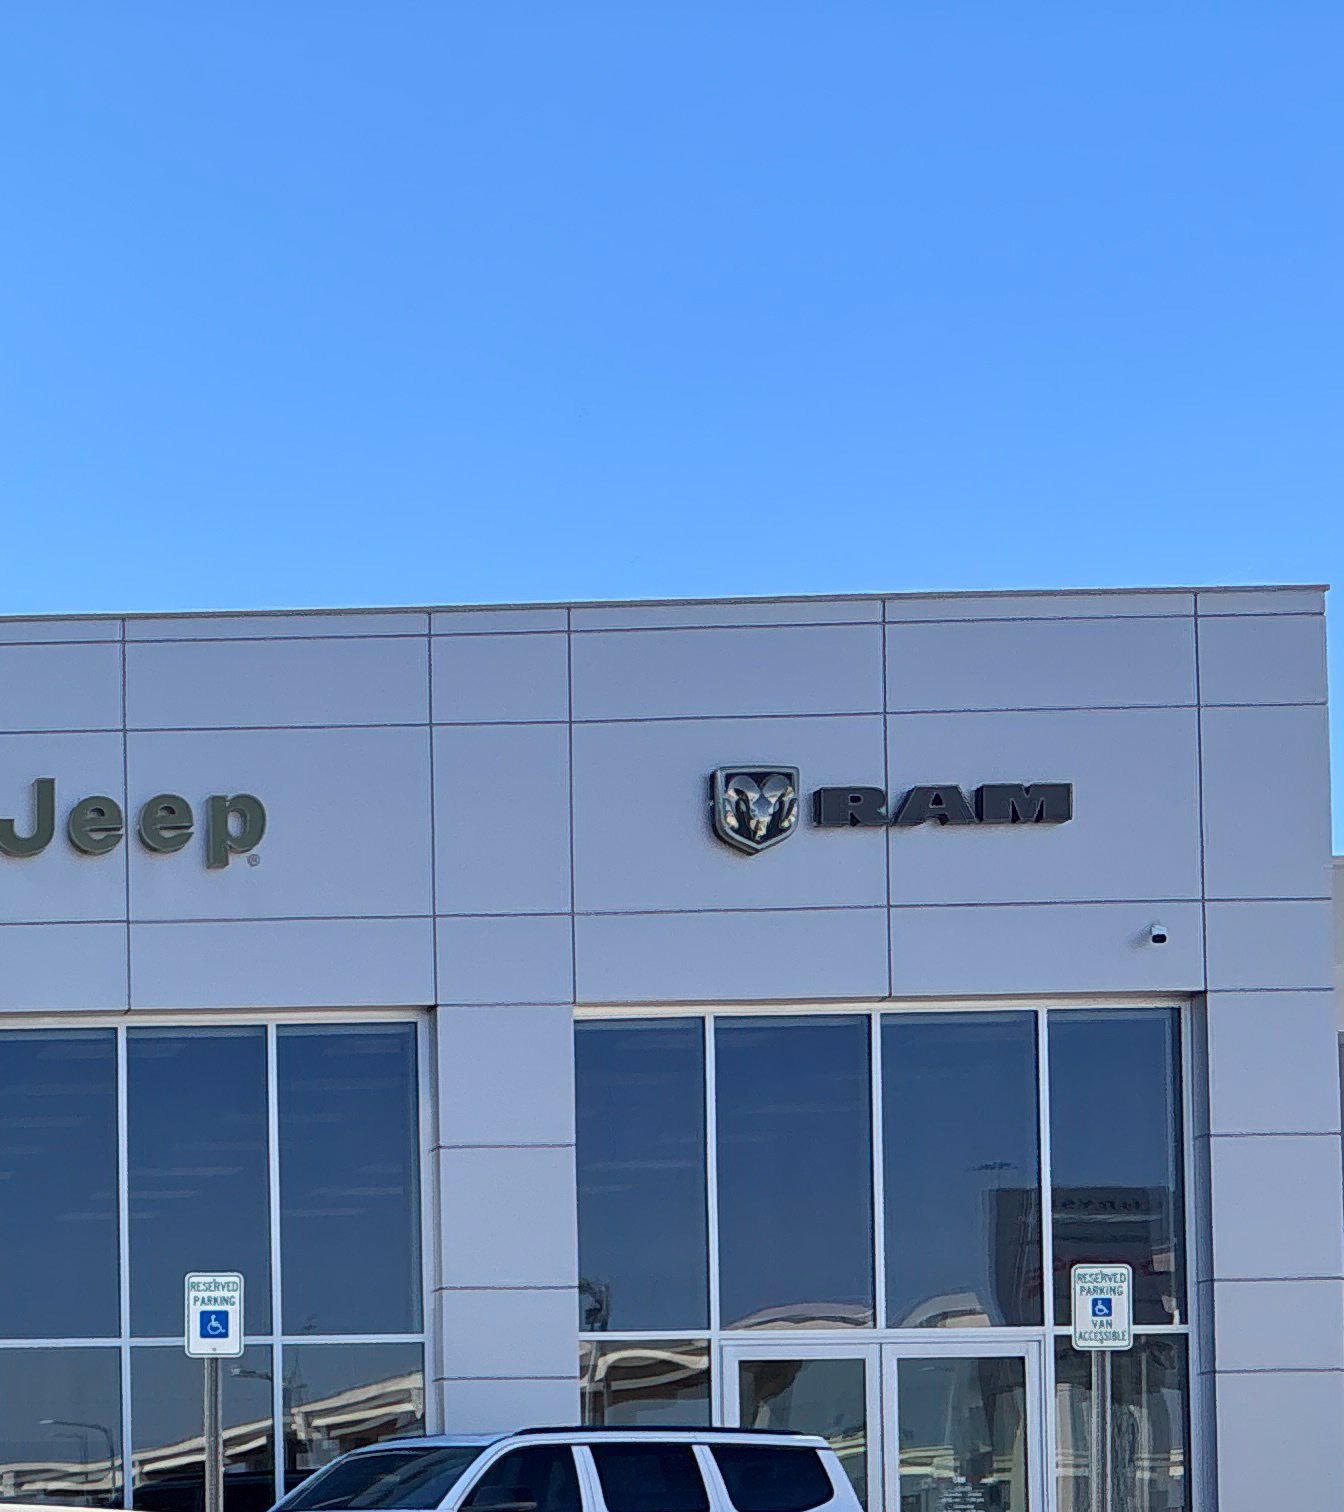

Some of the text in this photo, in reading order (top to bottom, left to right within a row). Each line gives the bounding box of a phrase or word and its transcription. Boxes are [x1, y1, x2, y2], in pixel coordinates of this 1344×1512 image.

[813, 783, 1073, 827] RAM
[1077, 1271, 1127, 1285] RESERVED
[190, 1281, 239, 1293] RESERVED
[1079, 1286, 1124, 1297] PARKING
[193, 1296, 236, 1307] PARKING
[1091, 1319, 1113, 1330] VAN
[1078, 1331, 1127, 1342] ACCESSIBLE
